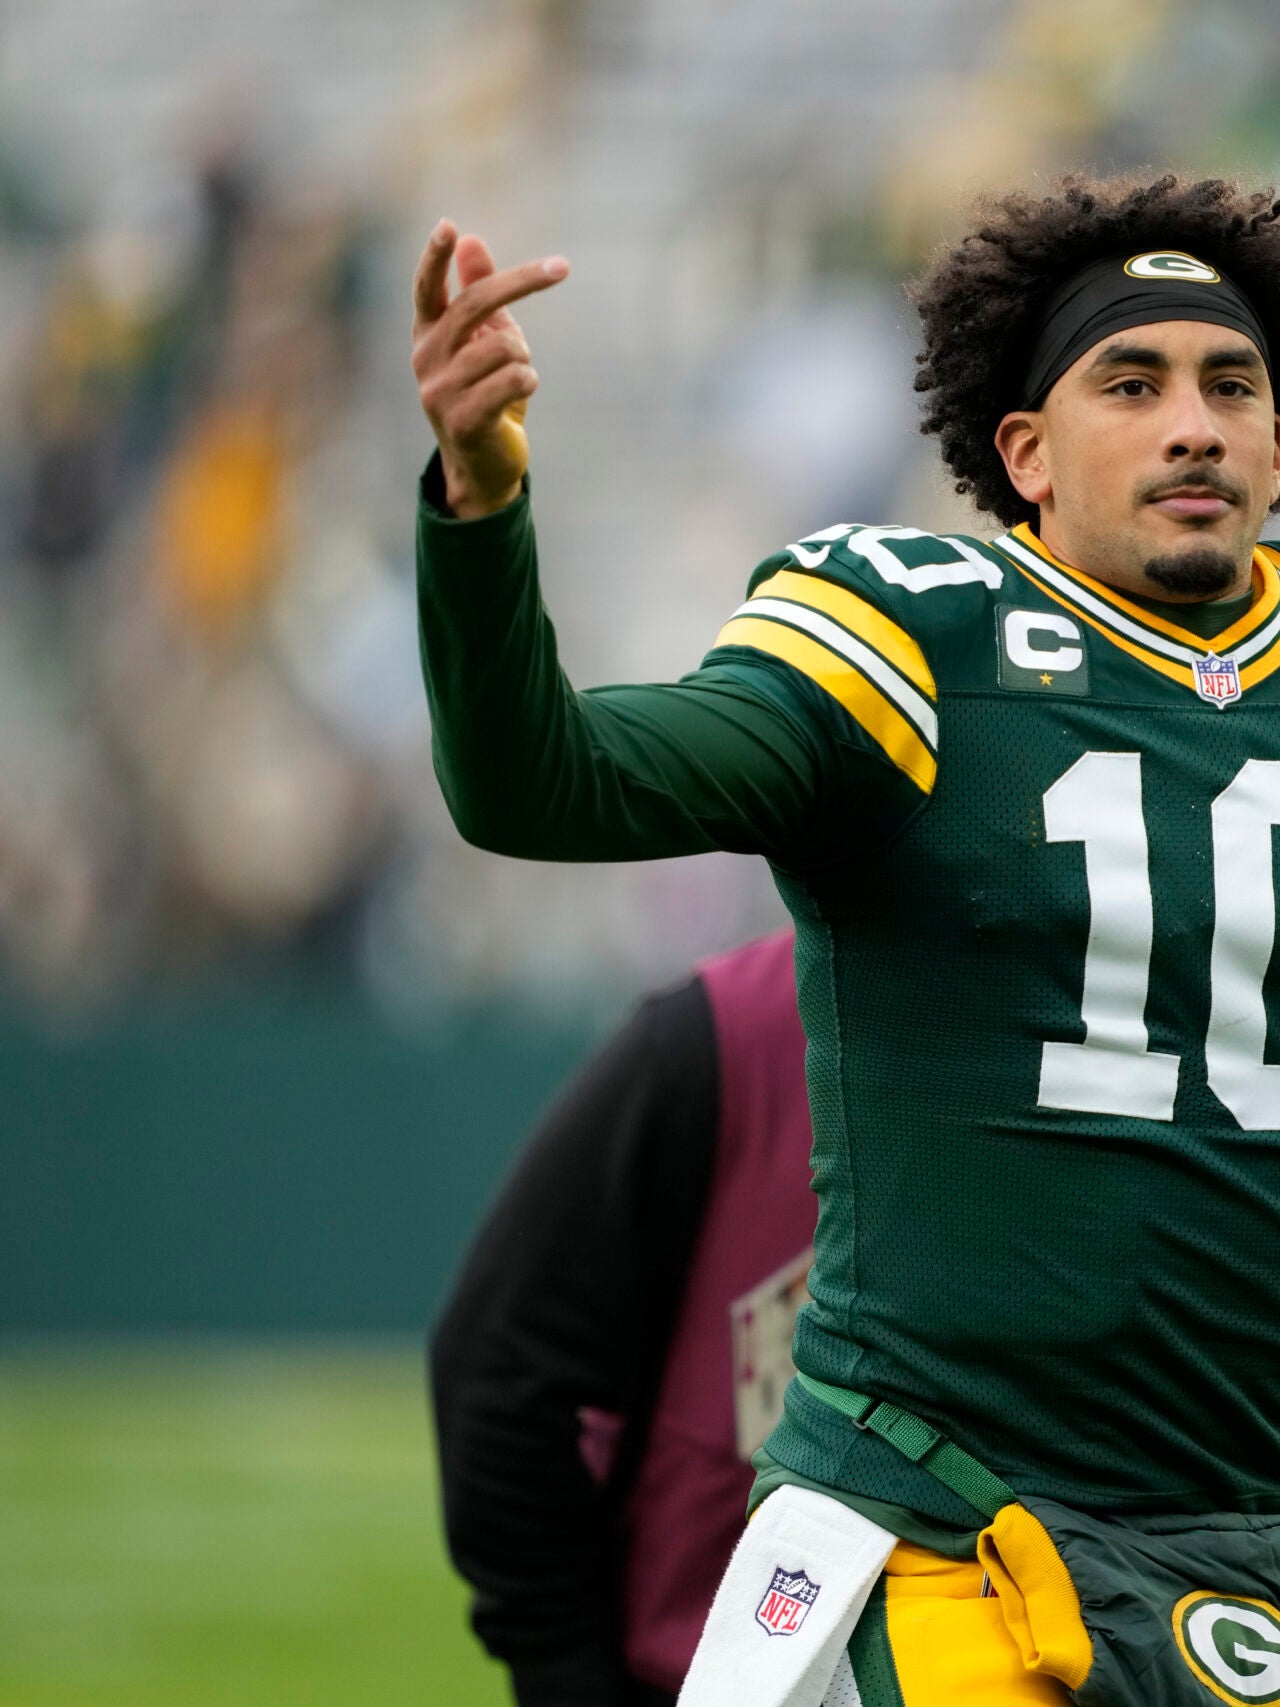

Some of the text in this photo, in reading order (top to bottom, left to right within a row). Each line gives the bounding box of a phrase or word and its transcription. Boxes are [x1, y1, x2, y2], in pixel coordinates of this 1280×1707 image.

[1129, 252, 1217, 281] G
[1004, 610, 1083, 672] C
[1202, 674, 1235, 697] NFL
[760, 1591, 802, 1631] NFL
